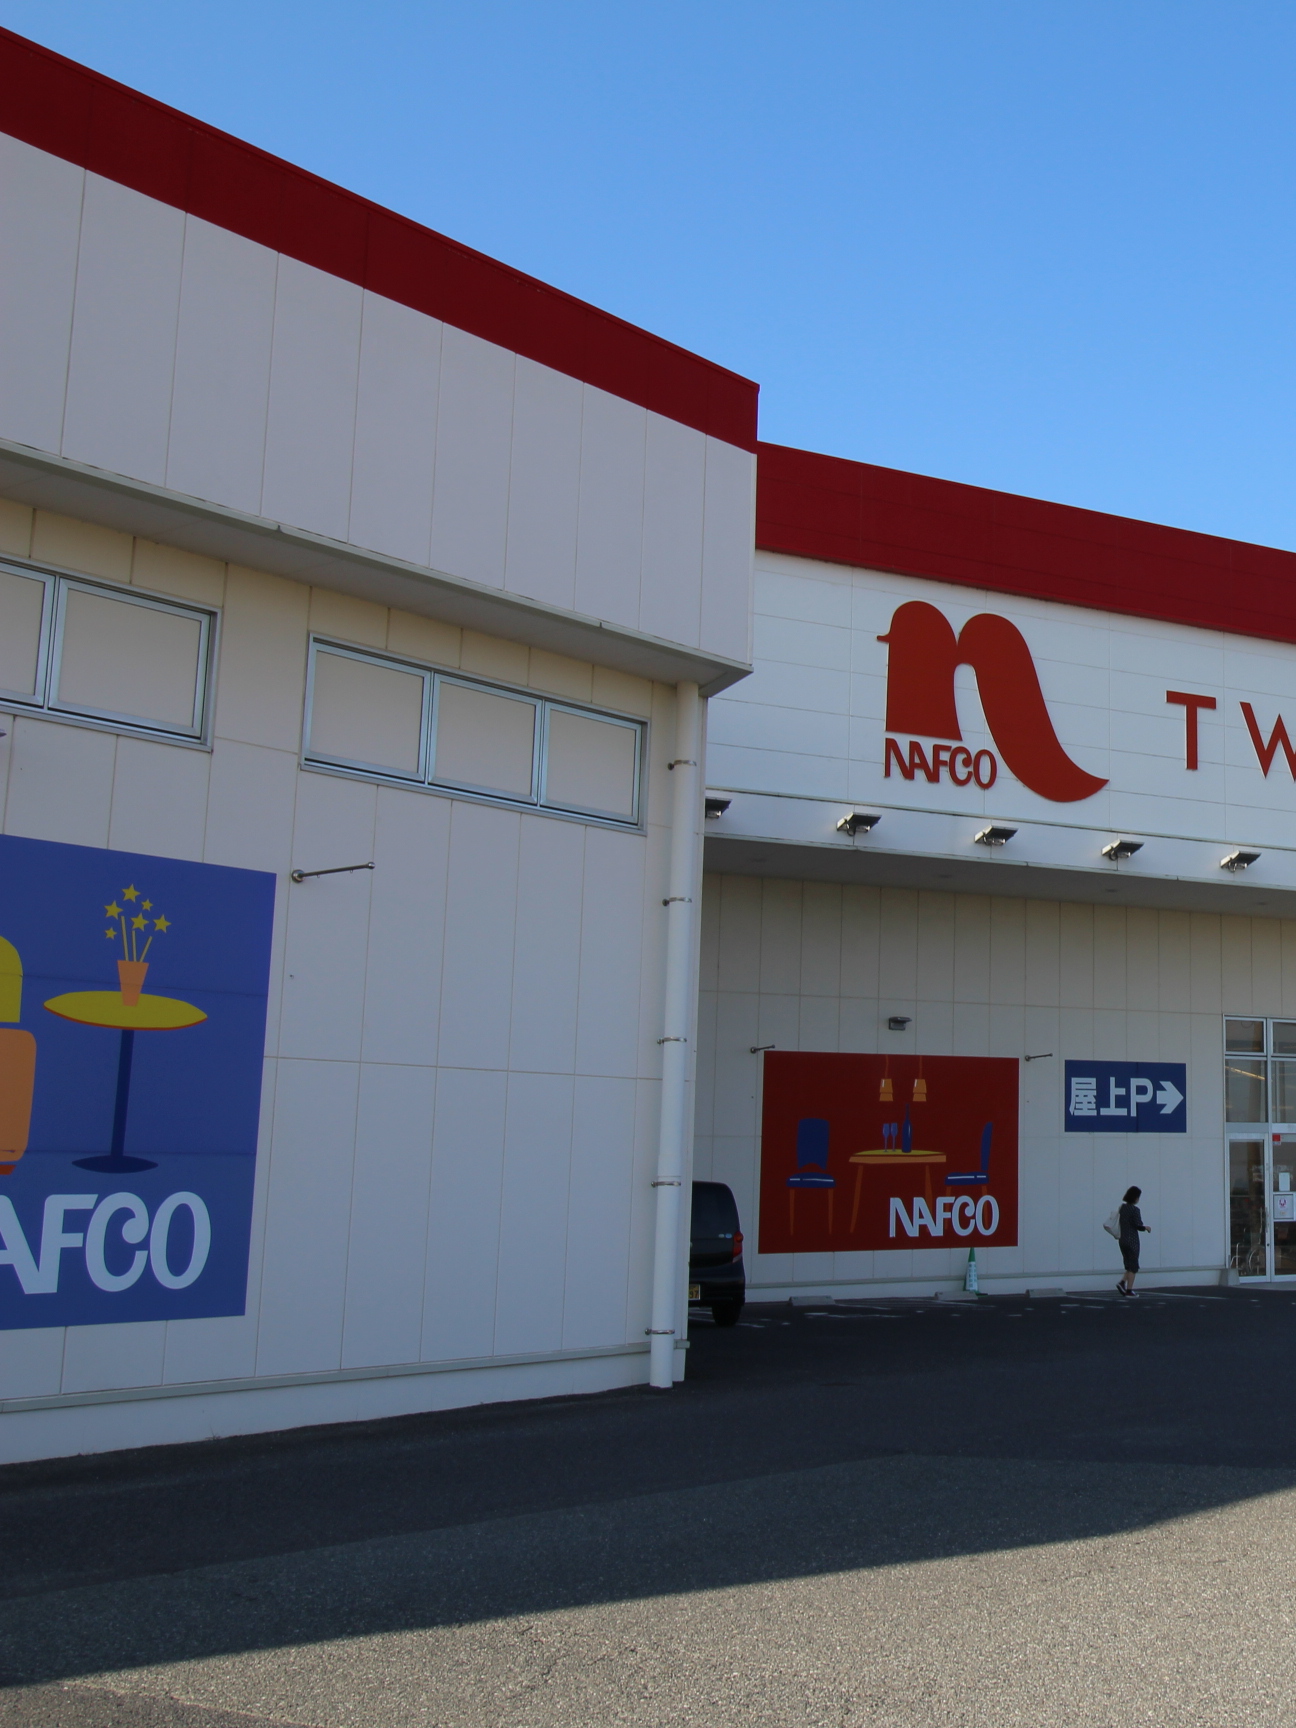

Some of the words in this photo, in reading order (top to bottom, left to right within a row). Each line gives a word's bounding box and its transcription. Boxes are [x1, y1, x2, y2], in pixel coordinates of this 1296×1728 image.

[883, 737, 998, 790] NAFCO
[1069, 1076, 1153, 1117] 屋上P
[889, 1194, 1000, 1238] NAFCO
